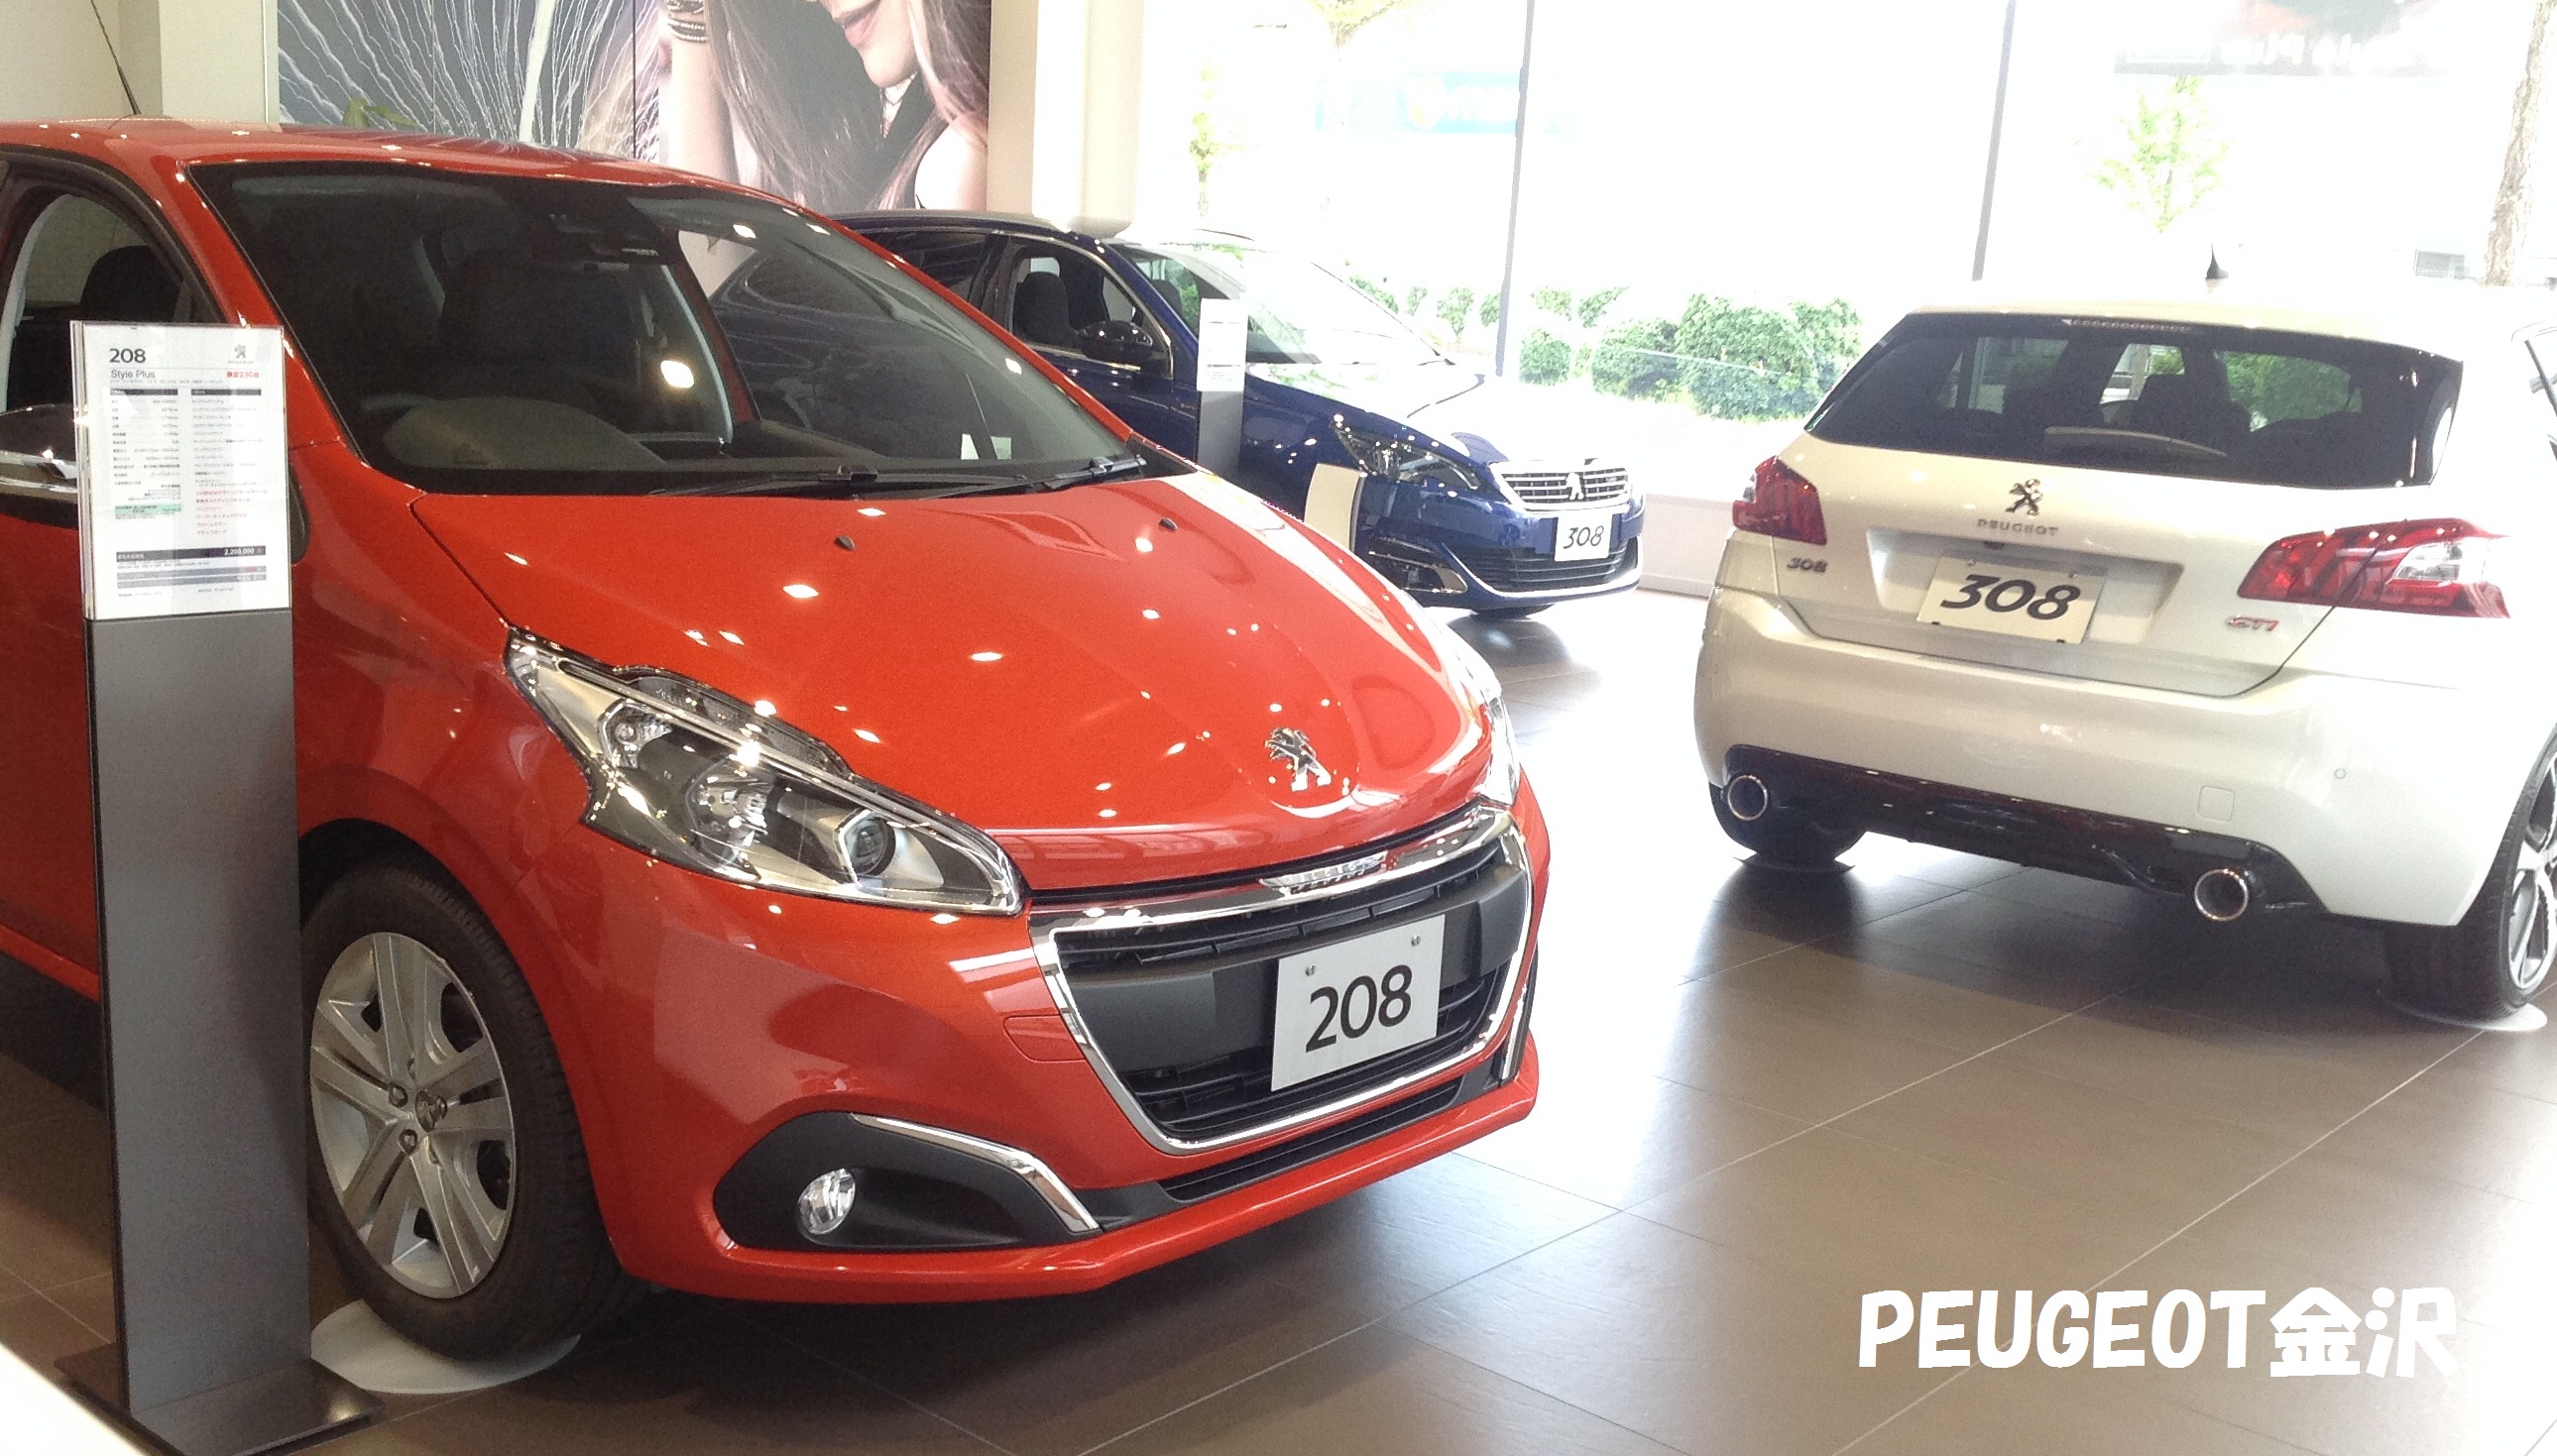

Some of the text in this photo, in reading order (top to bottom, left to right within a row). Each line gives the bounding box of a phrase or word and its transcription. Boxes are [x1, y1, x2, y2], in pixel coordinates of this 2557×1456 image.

[109, 348, 147, 363] 208
[111, 370, 134, 380] Style
[1563, 525, 1605, 549] 308
[1977, 517, 2059, 537] PEUGEOT
[1787, 556, 1826, 573] 308
[1940, 574, 2081, 620] 308
[1305, 964, 1413, 1054] 208
